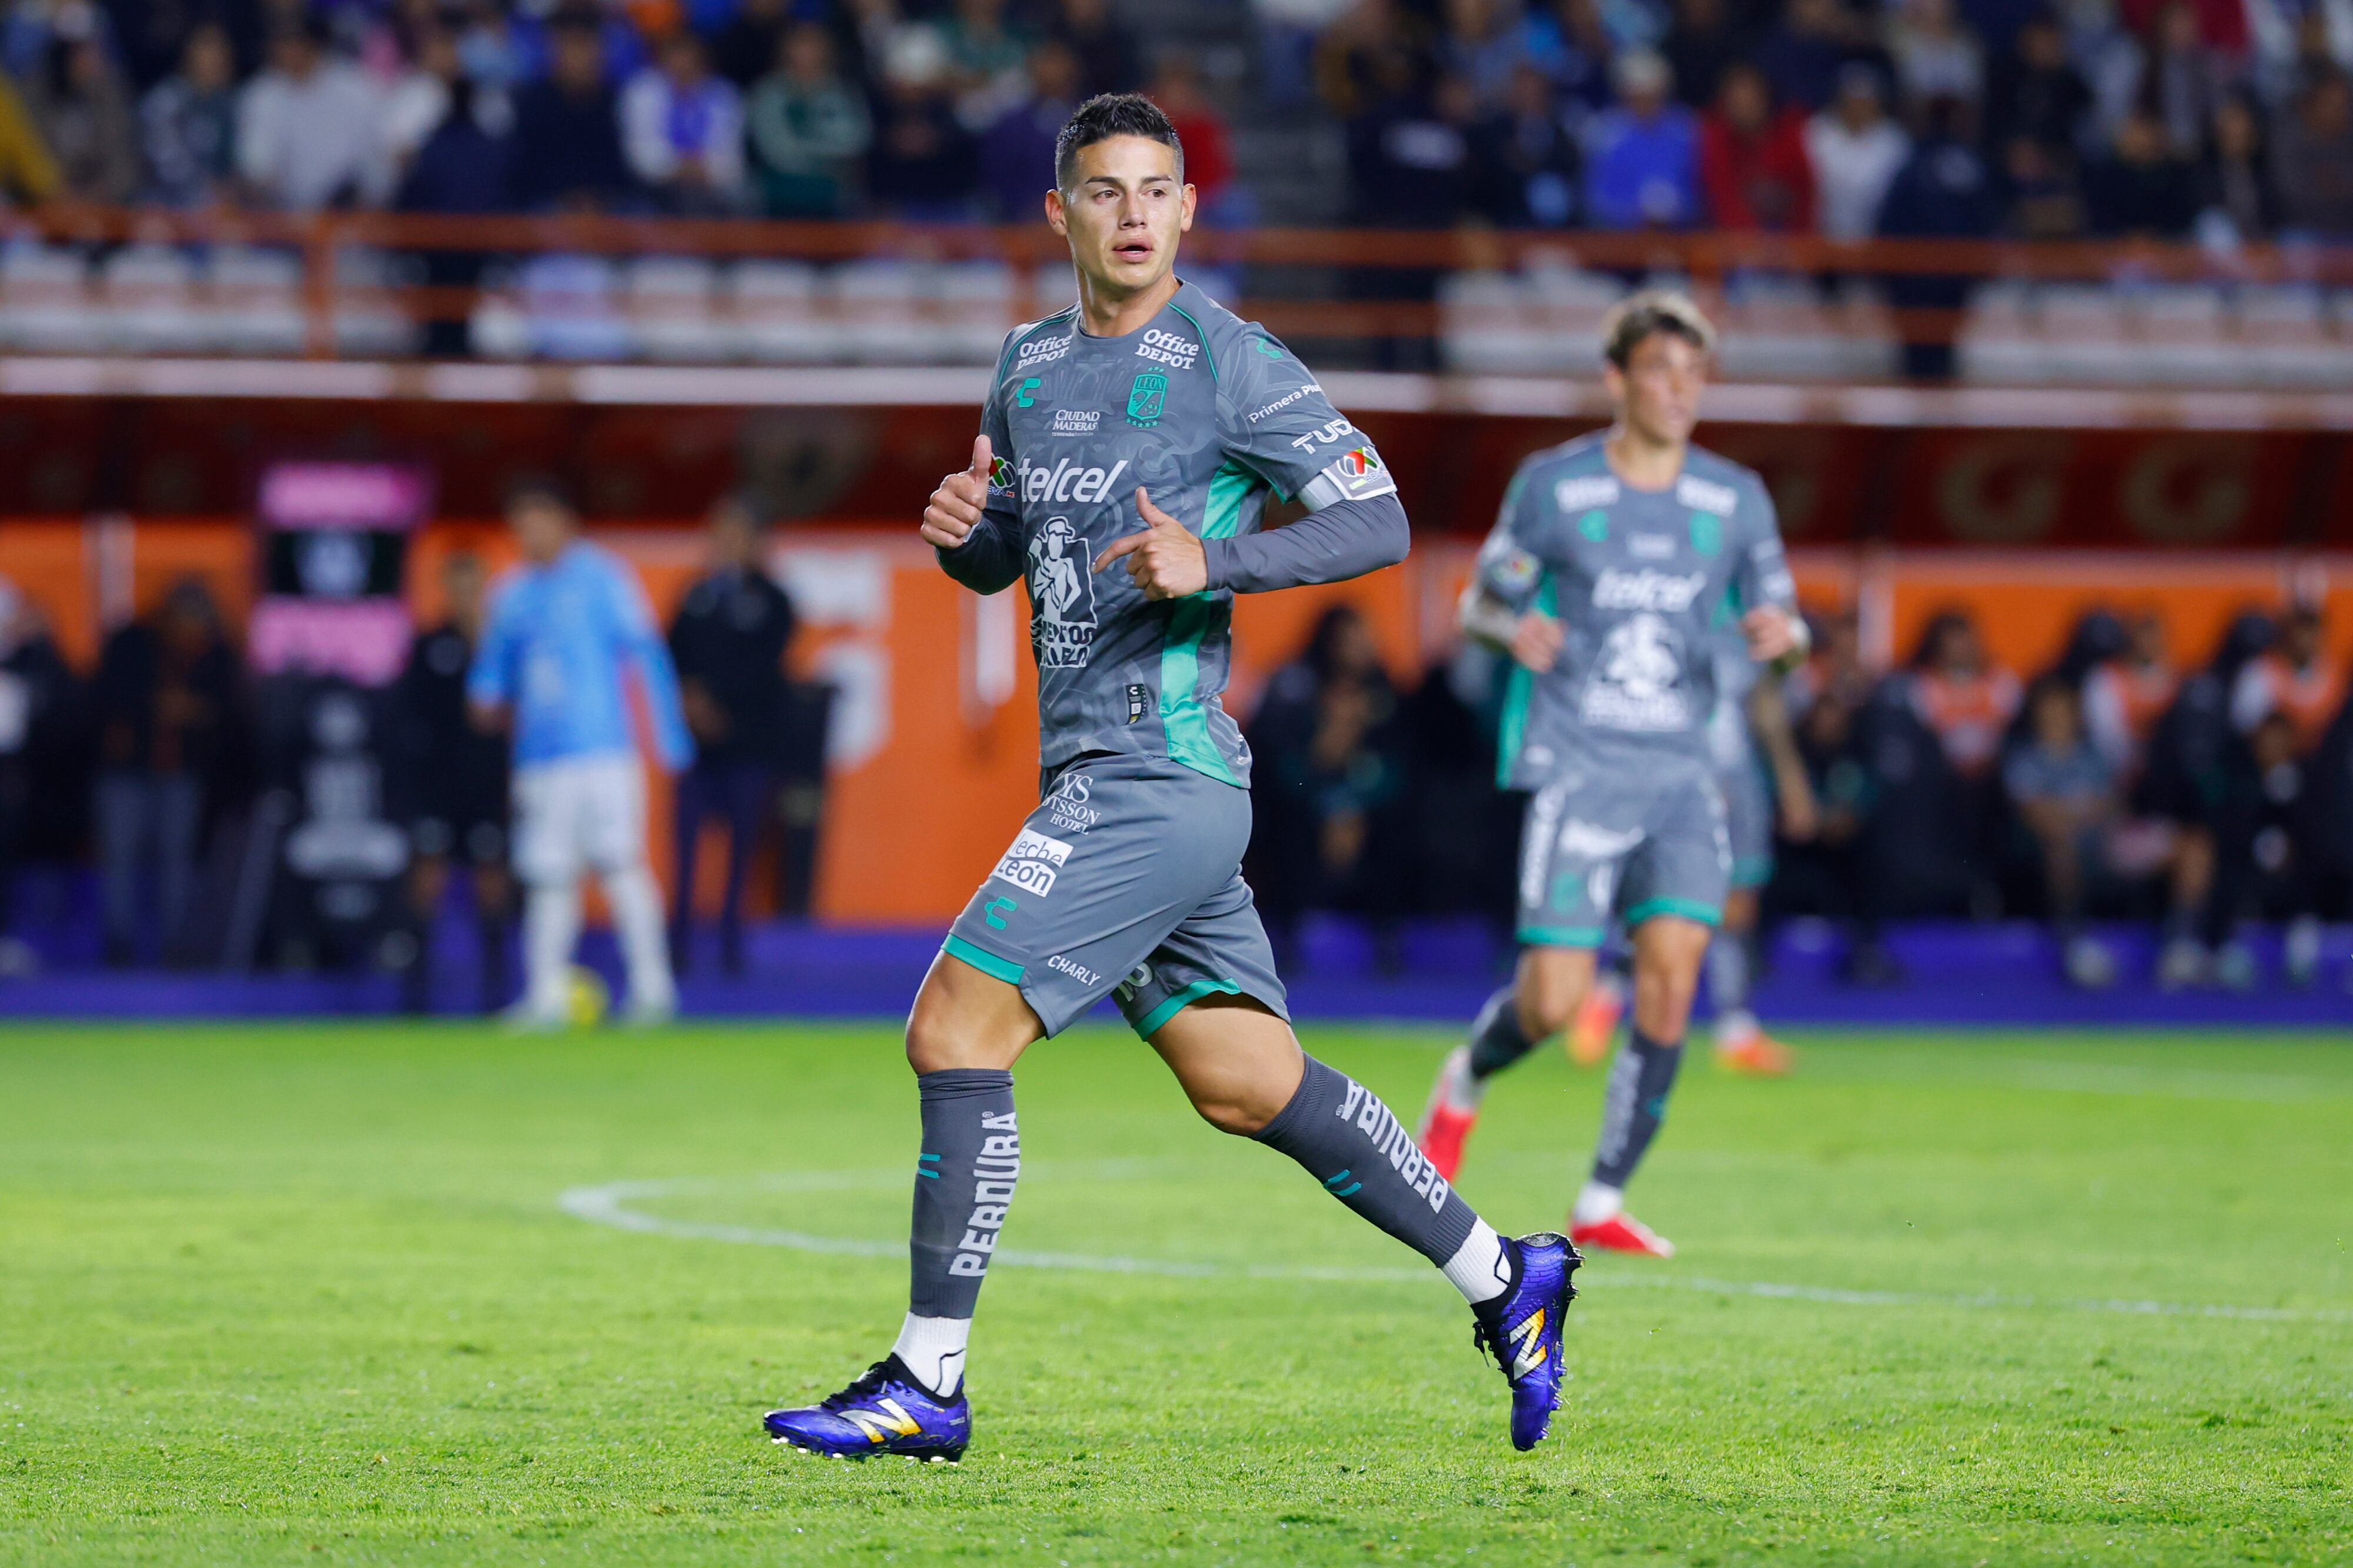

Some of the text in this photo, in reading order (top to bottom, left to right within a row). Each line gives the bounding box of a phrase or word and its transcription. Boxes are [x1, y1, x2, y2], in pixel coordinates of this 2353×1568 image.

[1019, 335, 1072, 358] Office
[1143, 329, 1199, 356] Office
[1016, 346, 1070, 371] DEPOT
[1135, 343, 1195, 369] DEPOT
[1055, 409, 1100, 421] CIUDAD
[1248, 391, 1302, 423] Primera
[1052, 420, 1098, 431] MADERAS
[1291, 419, 1359, 455] TUD
[1018, 458, 1129, 503] telcel
[1049, 813, 1089, 835] HOTEL
[1012, 833, 1062, 862] leche
[1047, 955, 1101, 986] CHARLY
